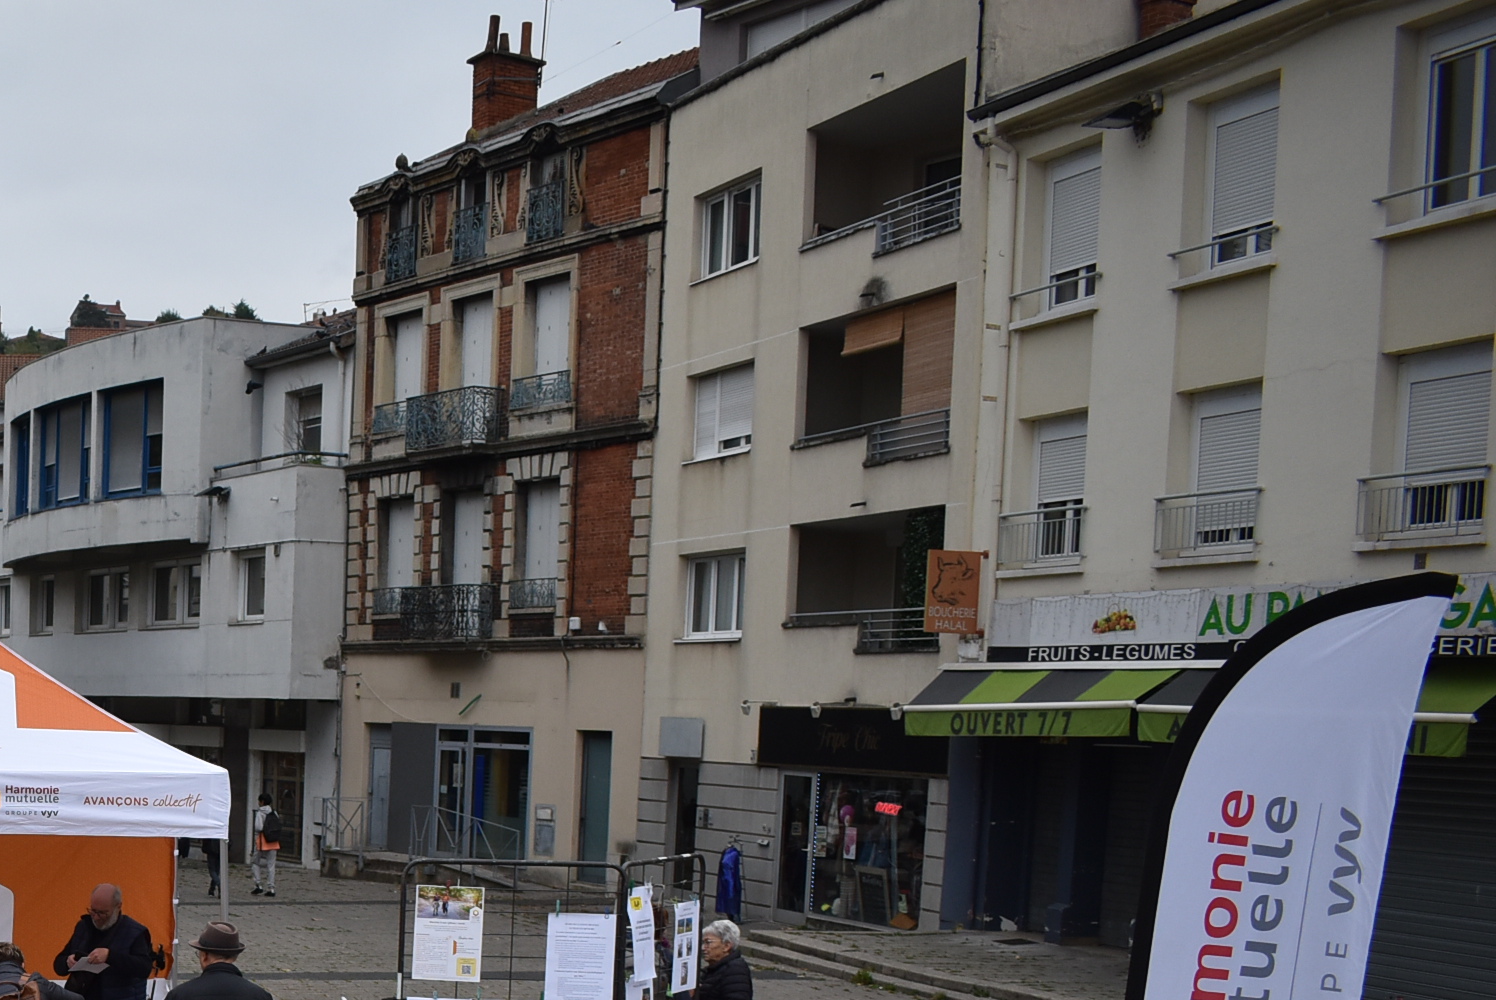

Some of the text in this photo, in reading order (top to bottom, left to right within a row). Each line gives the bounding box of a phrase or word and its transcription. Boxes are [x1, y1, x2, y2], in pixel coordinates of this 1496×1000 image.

[928, 606, 977, 619] BOUCHERIE
[1198, 593, 1253, 637] AU
[934, 620, 968, 631] HALAL
[950, 711, 1073, 736] OUVERT 7/7
[5, 784, 60, 795] Harmonie
[5, 793, 60, 804] mutuelle
[83, 793, 203, 814] AVANÇONS collectif
[40, 809, 60, 819] vyv
[1327, 806, 1362, 917] vyv
